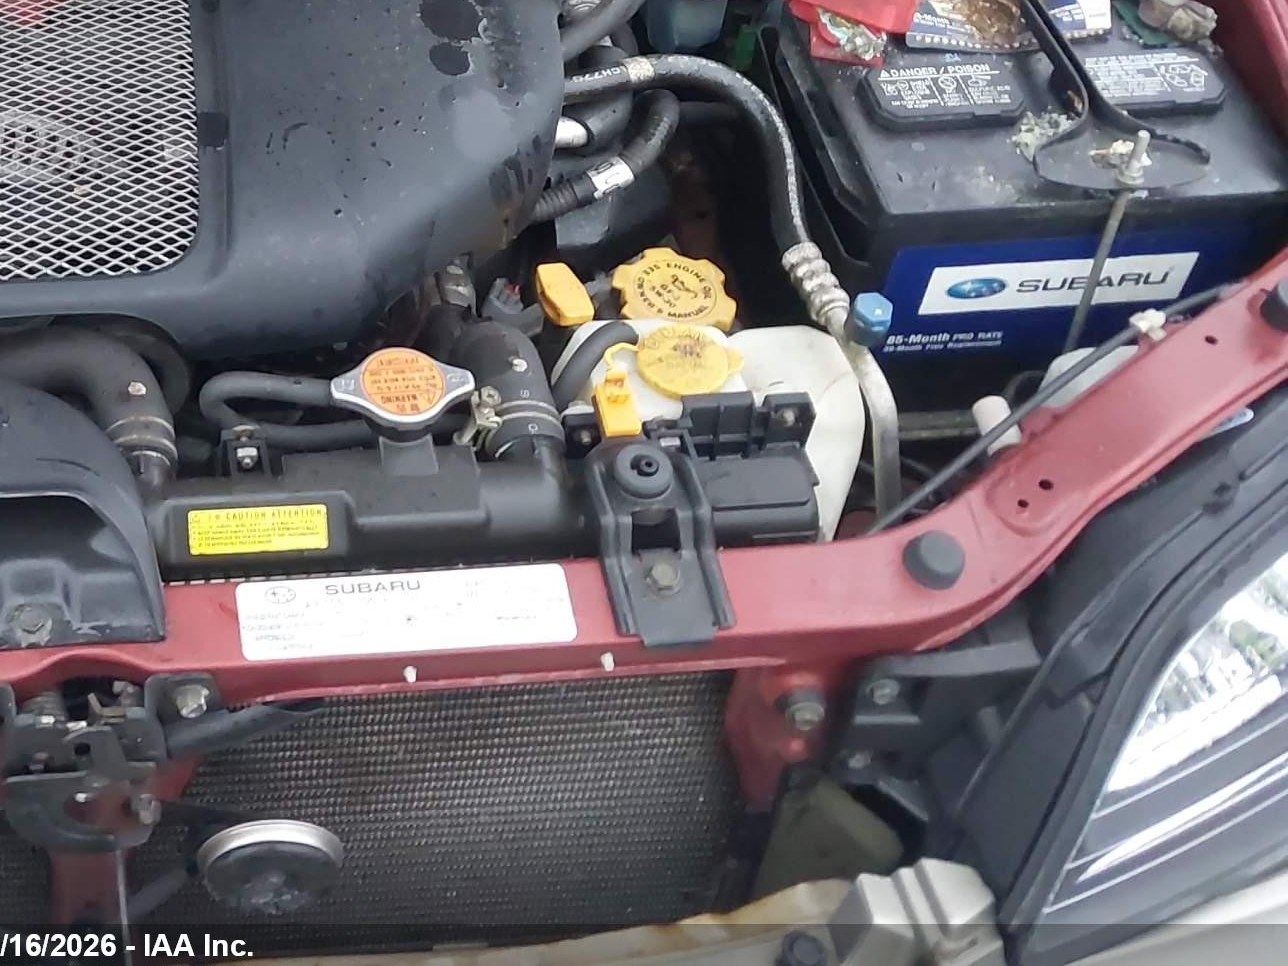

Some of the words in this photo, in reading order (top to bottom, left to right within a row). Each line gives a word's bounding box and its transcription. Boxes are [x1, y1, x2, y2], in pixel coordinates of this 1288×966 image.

[890, 66, 937, 78] DANGER
[947, 63, 991, 75] POISON
[666, 262, 705, 283] ENGINE
[1016, 270, 1170, 294] SUBARU
[225, 511, 266, 522] CAUTION
[271, 508, 323, 519] ATTENTION
[324, 580, 422, 596] SUBARU
